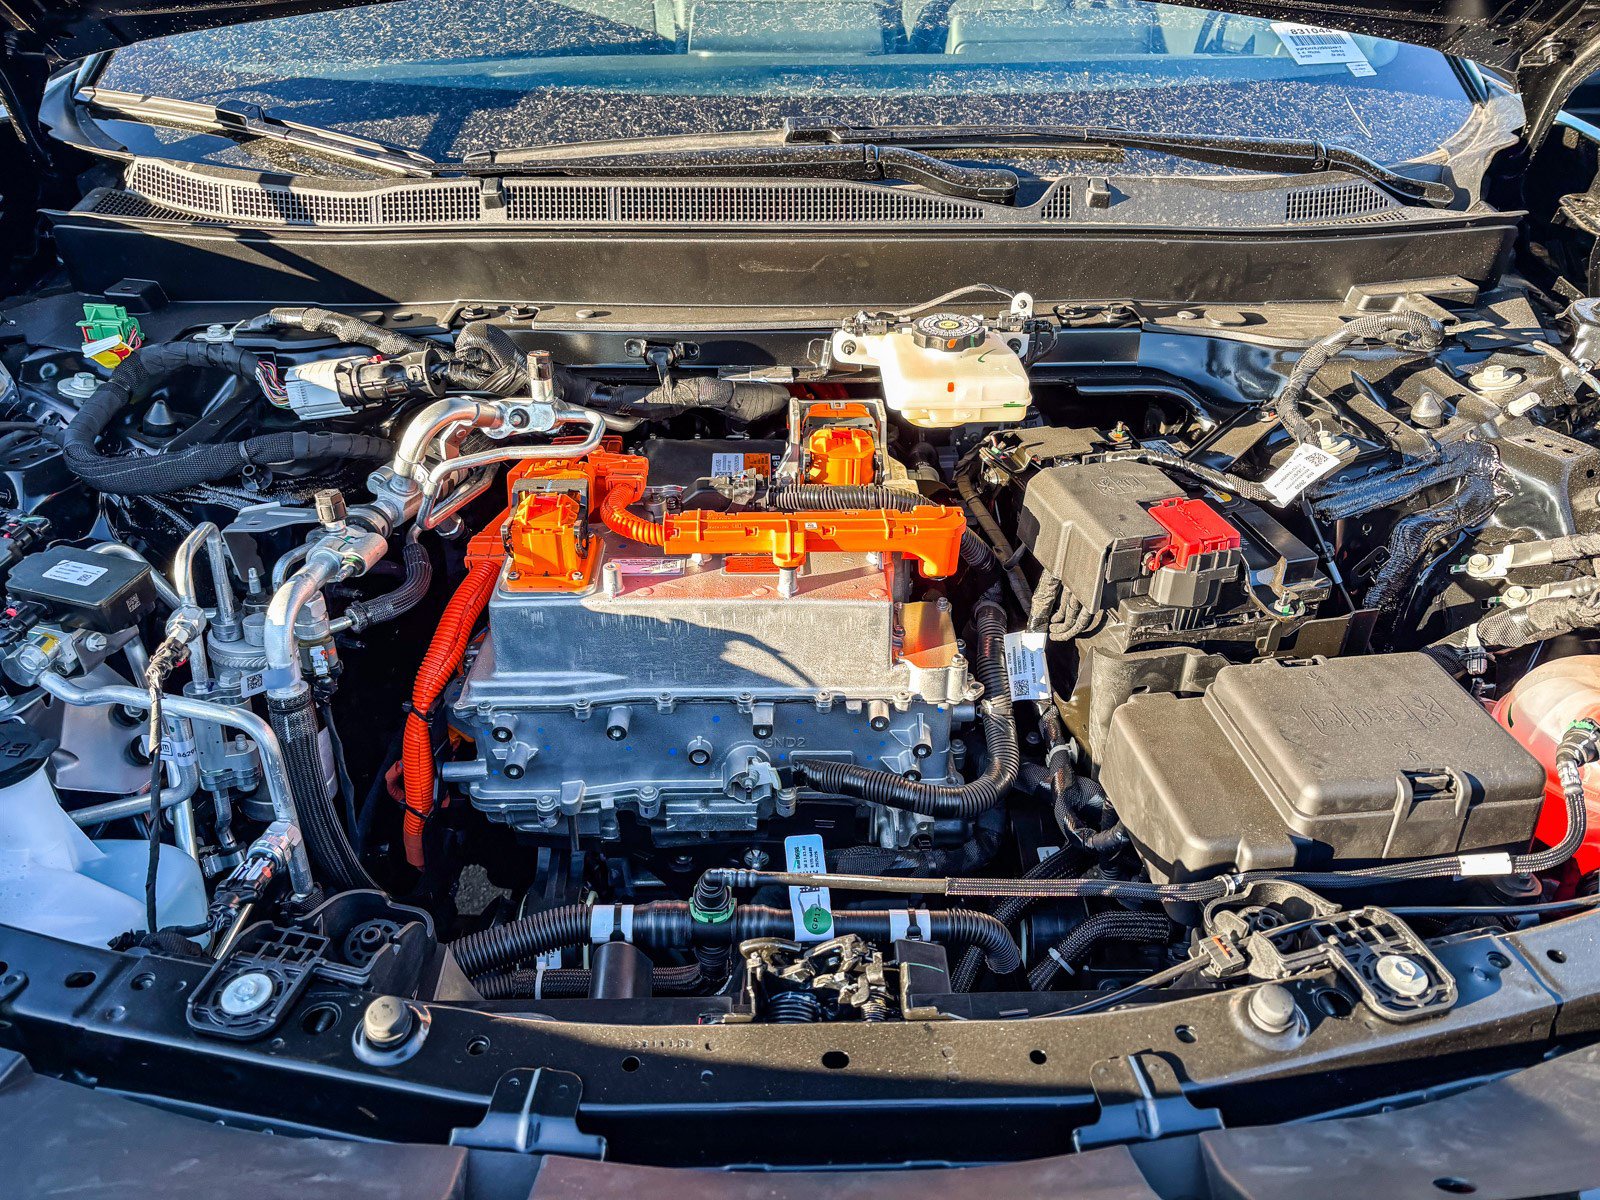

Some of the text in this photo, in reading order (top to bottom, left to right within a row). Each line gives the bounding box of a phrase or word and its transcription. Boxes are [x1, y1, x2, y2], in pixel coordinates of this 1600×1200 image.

[1289, 27, 1333, 35] 831044
[762, 737, 806, 748] GND2
[811, 907, 822, 930] GP12
